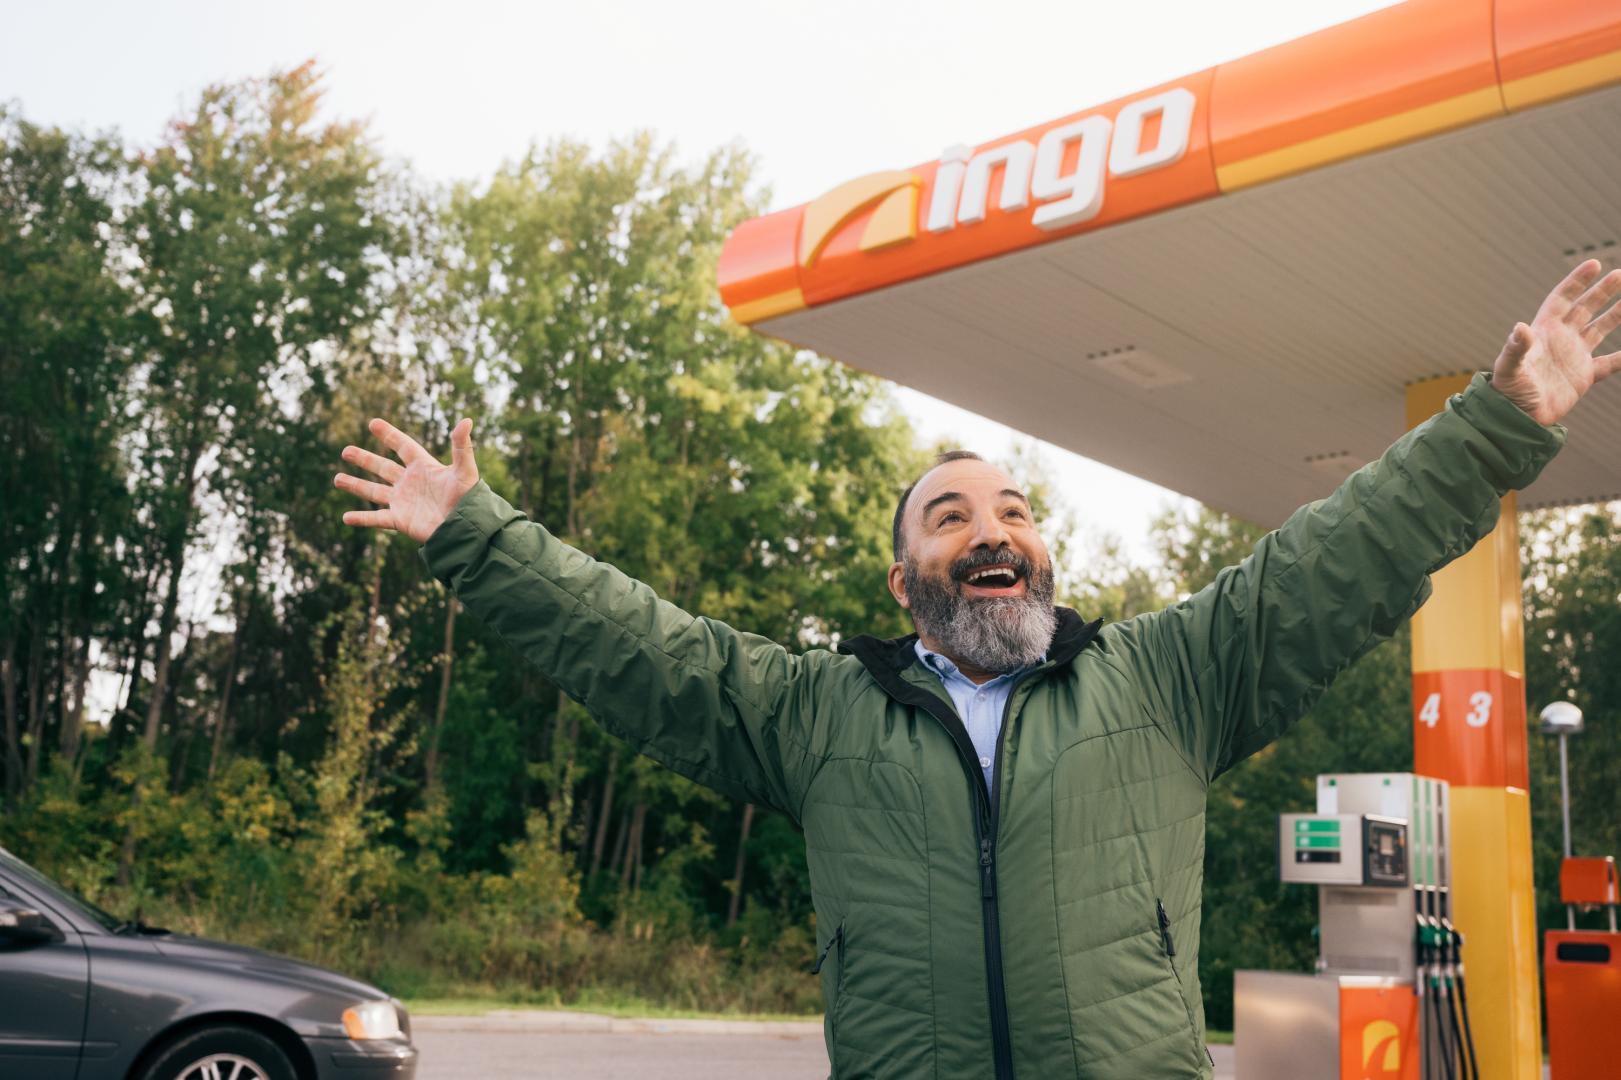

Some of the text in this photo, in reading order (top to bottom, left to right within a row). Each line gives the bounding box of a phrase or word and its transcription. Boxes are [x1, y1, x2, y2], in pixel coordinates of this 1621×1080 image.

[926, 86, 1196, 232] ingo
[1419, 691, 1492, 728] 4 3
